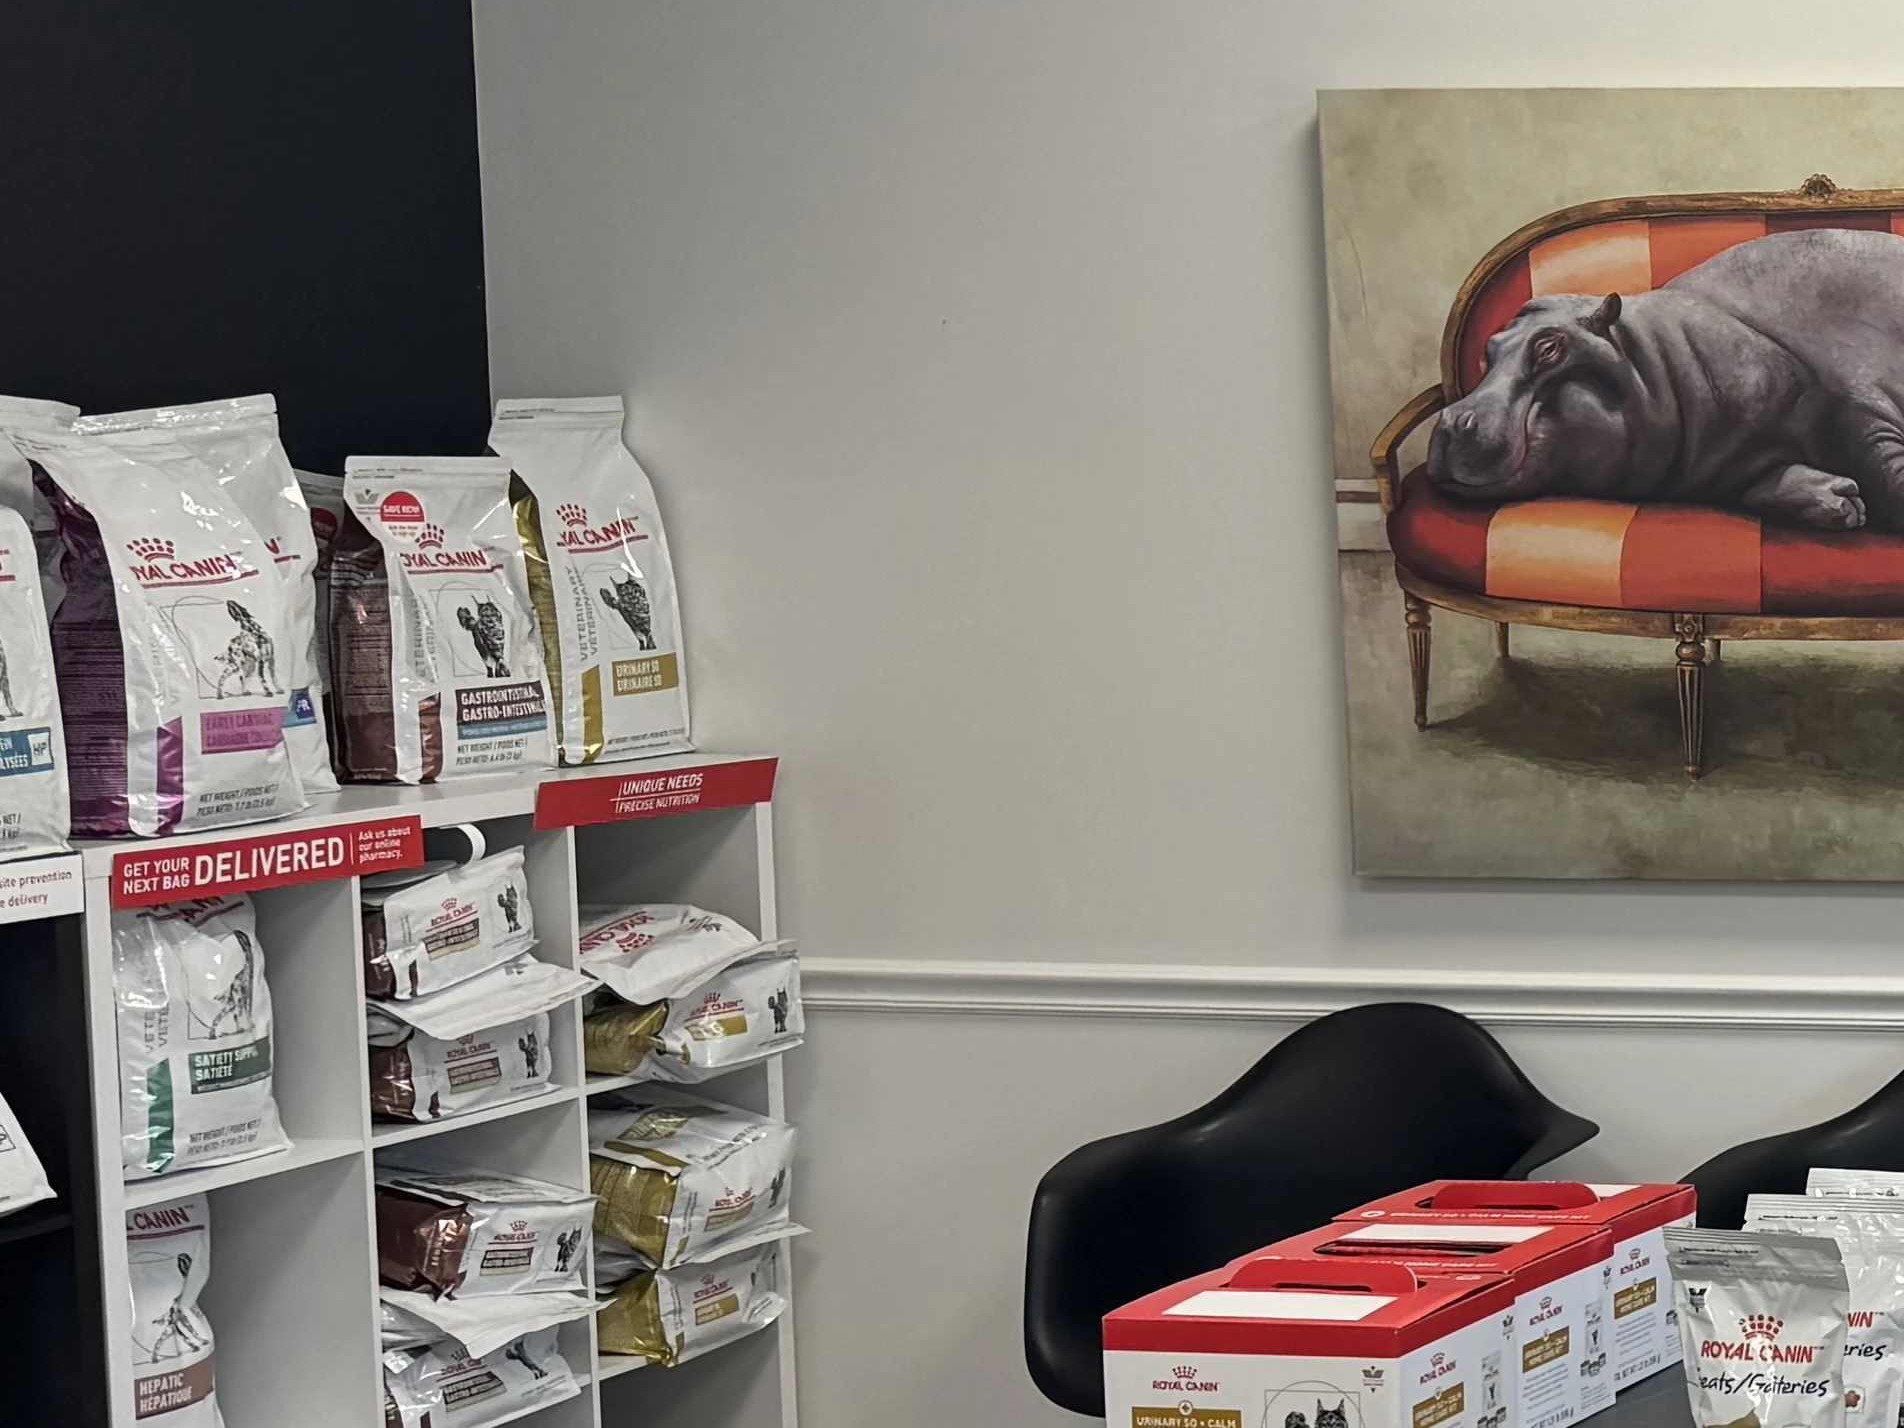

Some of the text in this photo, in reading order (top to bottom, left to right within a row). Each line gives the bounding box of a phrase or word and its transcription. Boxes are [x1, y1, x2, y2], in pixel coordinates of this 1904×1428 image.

[402, 552, 436, 568] OYAL
[623, 773, 704, 796] UNIQUE NEEDS
[123, 856, 190, 878] GET YOUR
[194, 836, 345, 886] DELIVERED
[19, 870, 72, 887] prevention
[123, 873, 190, 895] NEXT BAG
[8, 893, 48, 907] delivery
[133, 1206, 190, 1232] CANIN
[1701, 1339, 1814, 1364] ROYAL CANIN
[140, 1373, 185, 1396] HEPATIC
[1152, 1380, 1218, 1392] ROYAL CANIN
[1136, 1416, 1182, 1428] URINARY
